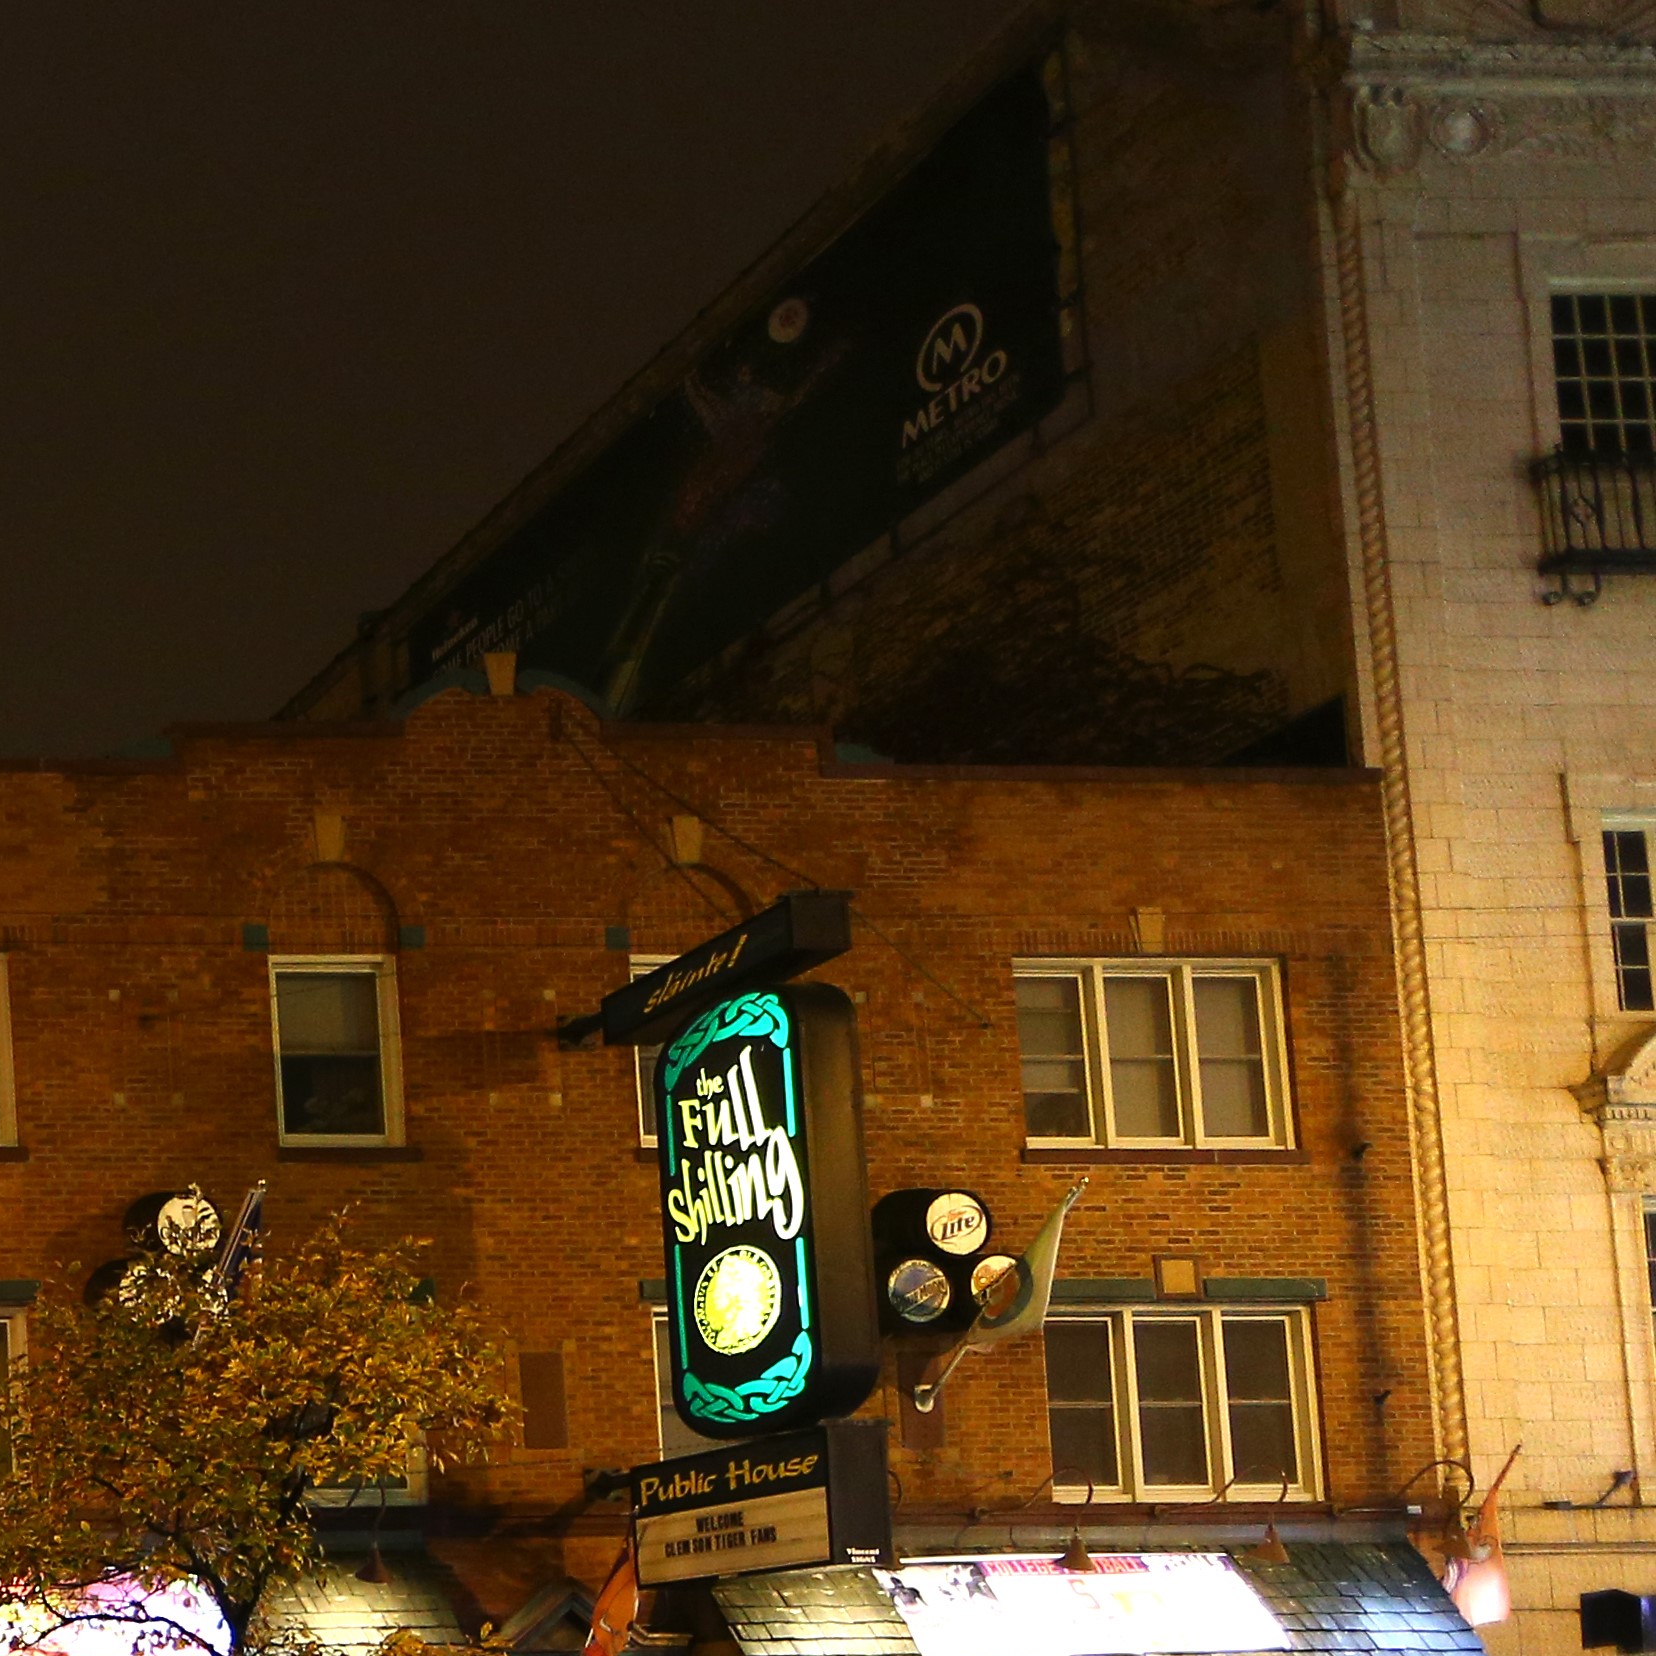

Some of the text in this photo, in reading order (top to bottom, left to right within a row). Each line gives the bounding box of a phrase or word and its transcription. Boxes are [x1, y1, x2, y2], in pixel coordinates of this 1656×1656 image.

[901, 350, 1009, 449] METRO
[678, 1045, 772, 1151] Full
[696, 1068, 724, 1100] the
[941, 1215, 975, 1241] Lite
[640, 1454, 819, 1507] Public House
[696, 1512, 744, 1533] WELCOME
[714, 1532, 746, 1551] TIGER
[751, 1527, 777, 1545] FANS
[987, 1558, 1060, 1576] COLLEGE
